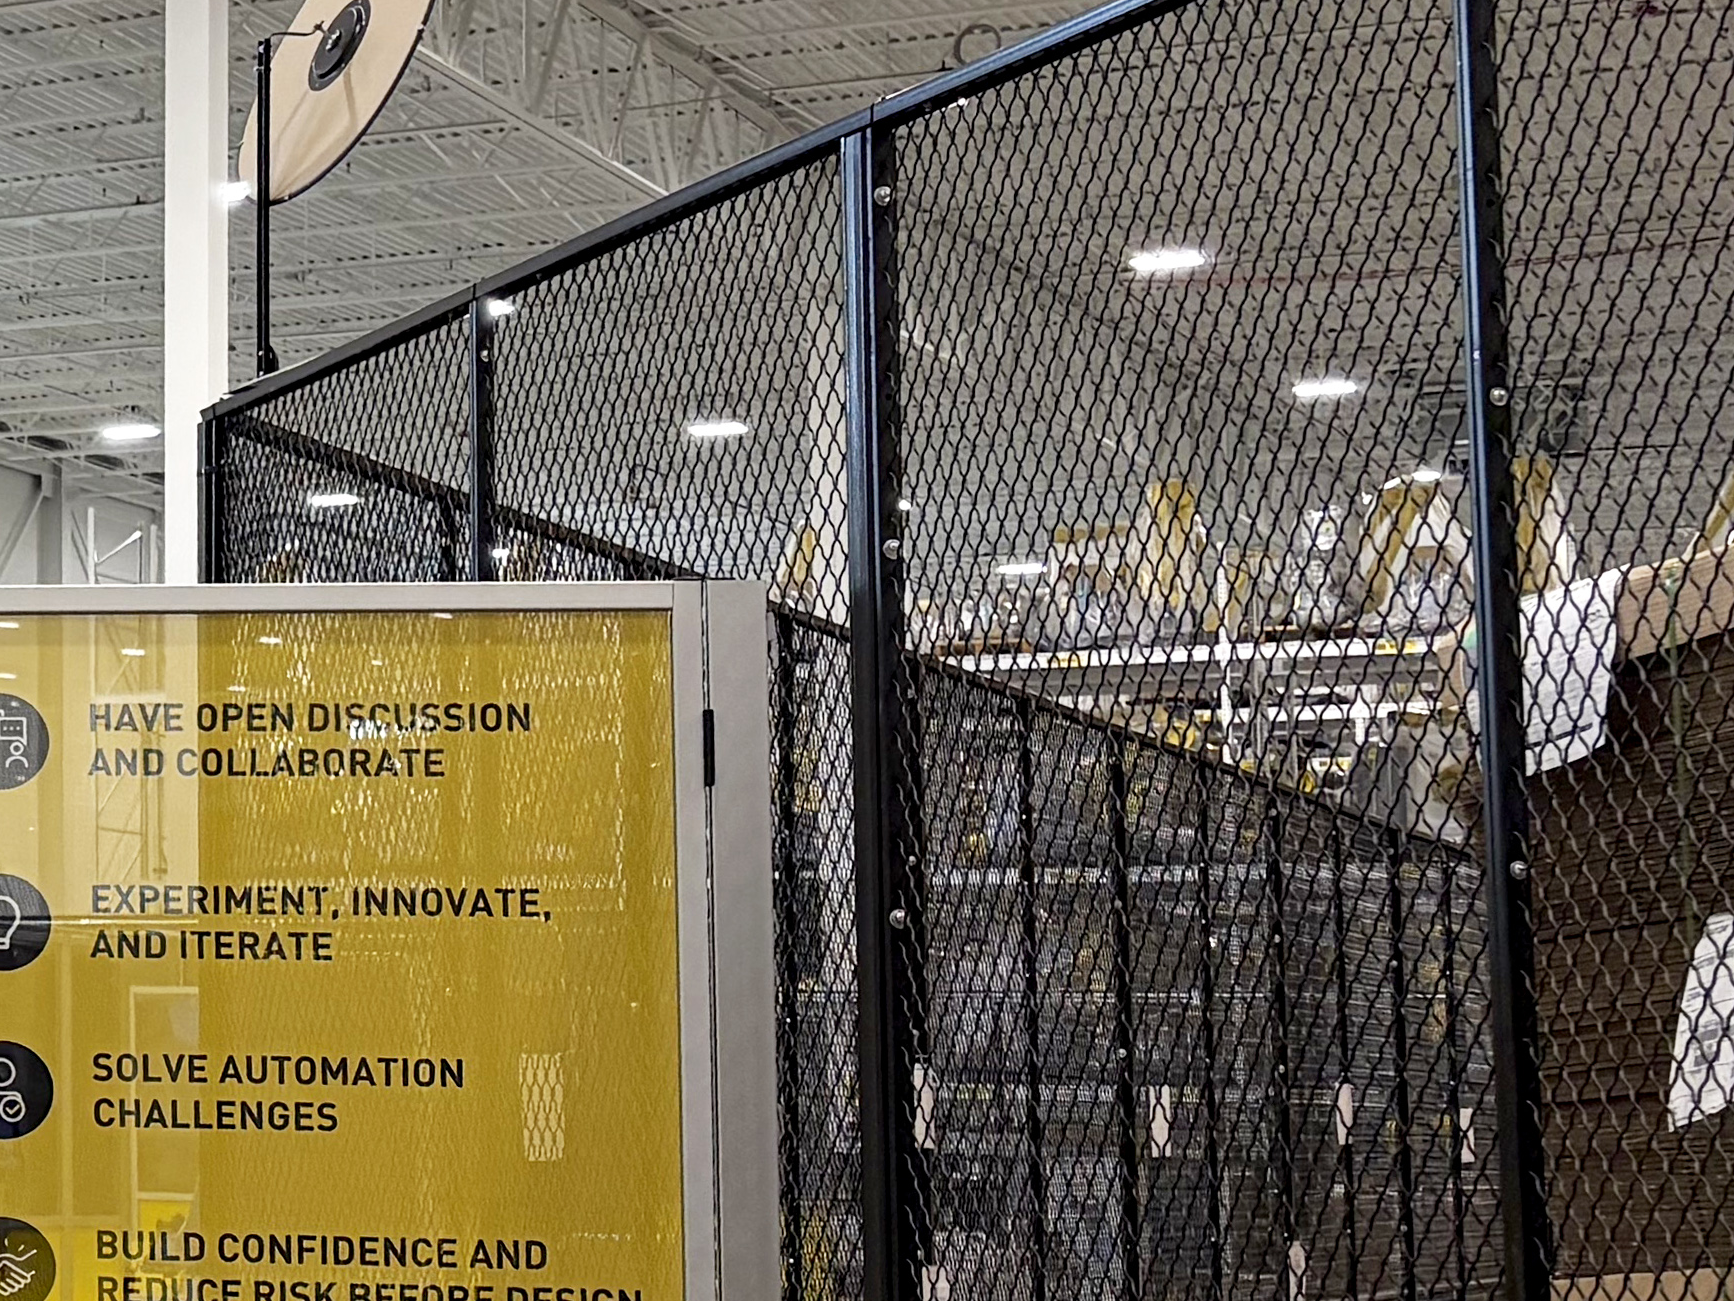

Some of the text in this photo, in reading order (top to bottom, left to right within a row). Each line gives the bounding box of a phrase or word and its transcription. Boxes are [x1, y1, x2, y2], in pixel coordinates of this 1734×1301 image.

[89, 703, 531, 734] HAVE OPEN DISCUSSION
[88, 747, 446, 778] AND COLLABORATE
[91, 884, 552, 923] EXPERIMENT, INNOVATE,
[90, 929, 333, 962] AND ITERATE
[92, 1052, 464, 1089] SOLVE AUTOMATION
[92, 1097, 339, 1133] CHALLENGES
[96, 1229, 548, 1271] BUILD CONFIDENCE AND
